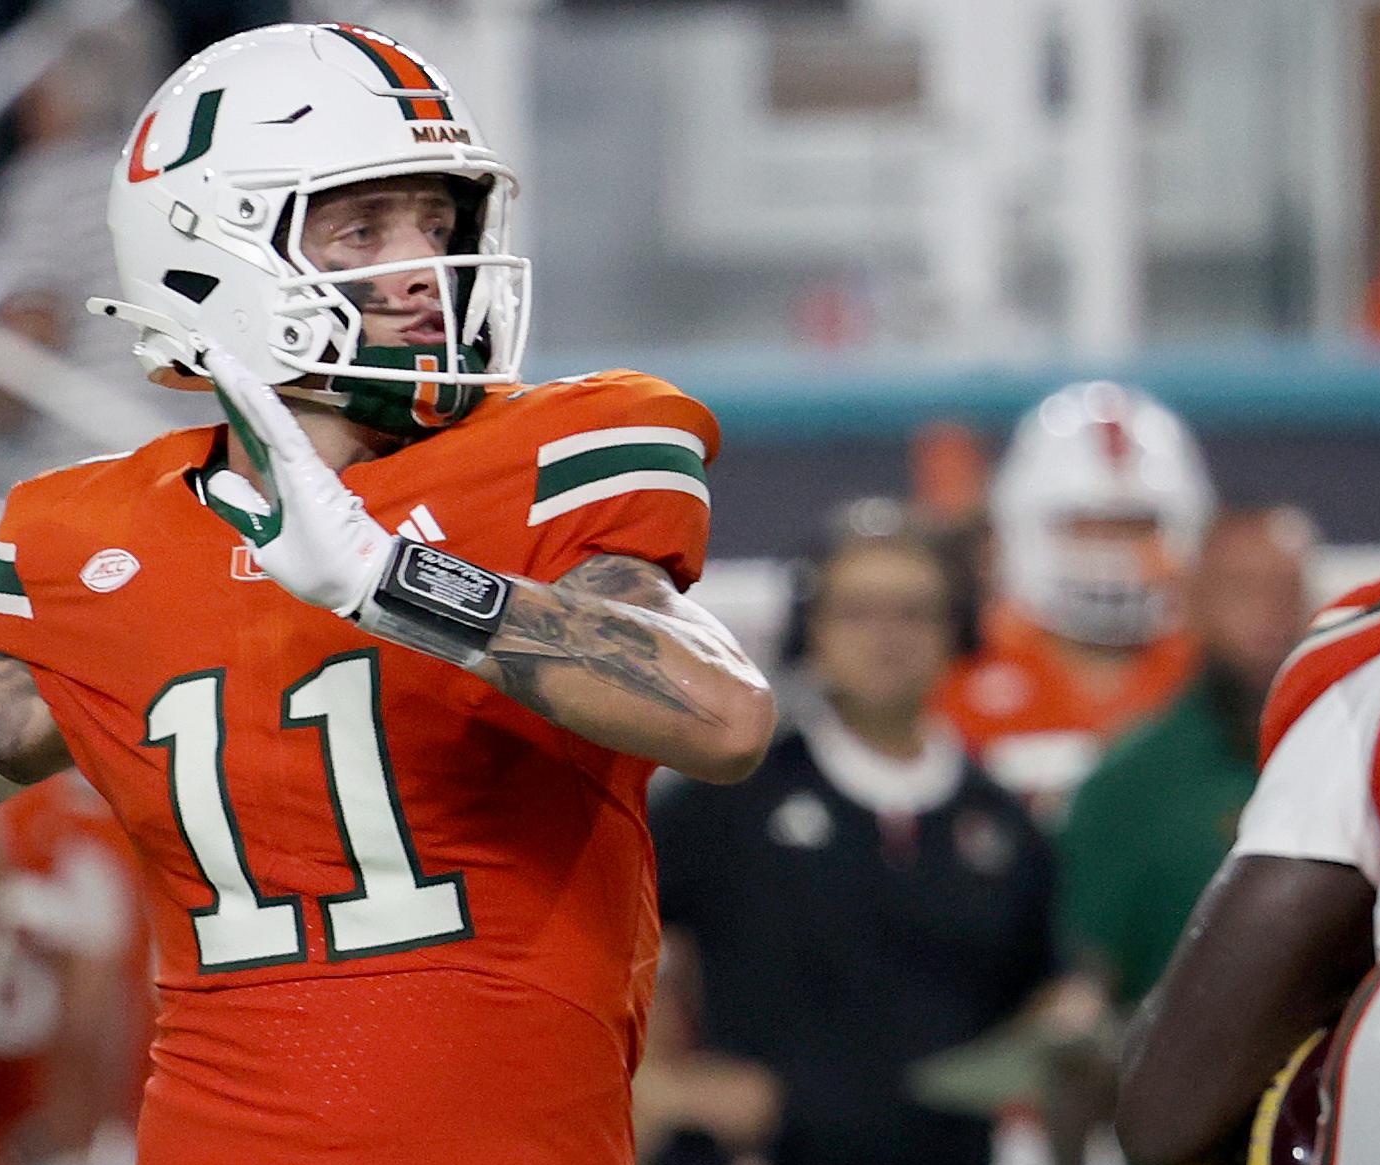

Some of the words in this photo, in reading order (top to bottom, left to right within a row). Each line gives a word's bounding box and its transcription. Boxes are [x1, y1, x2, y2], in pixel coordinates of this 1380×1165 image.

[127, 88, 225, 184] U
[410, 126, 472, 145] MIAMI
[139, 646, 475, 975] 11
